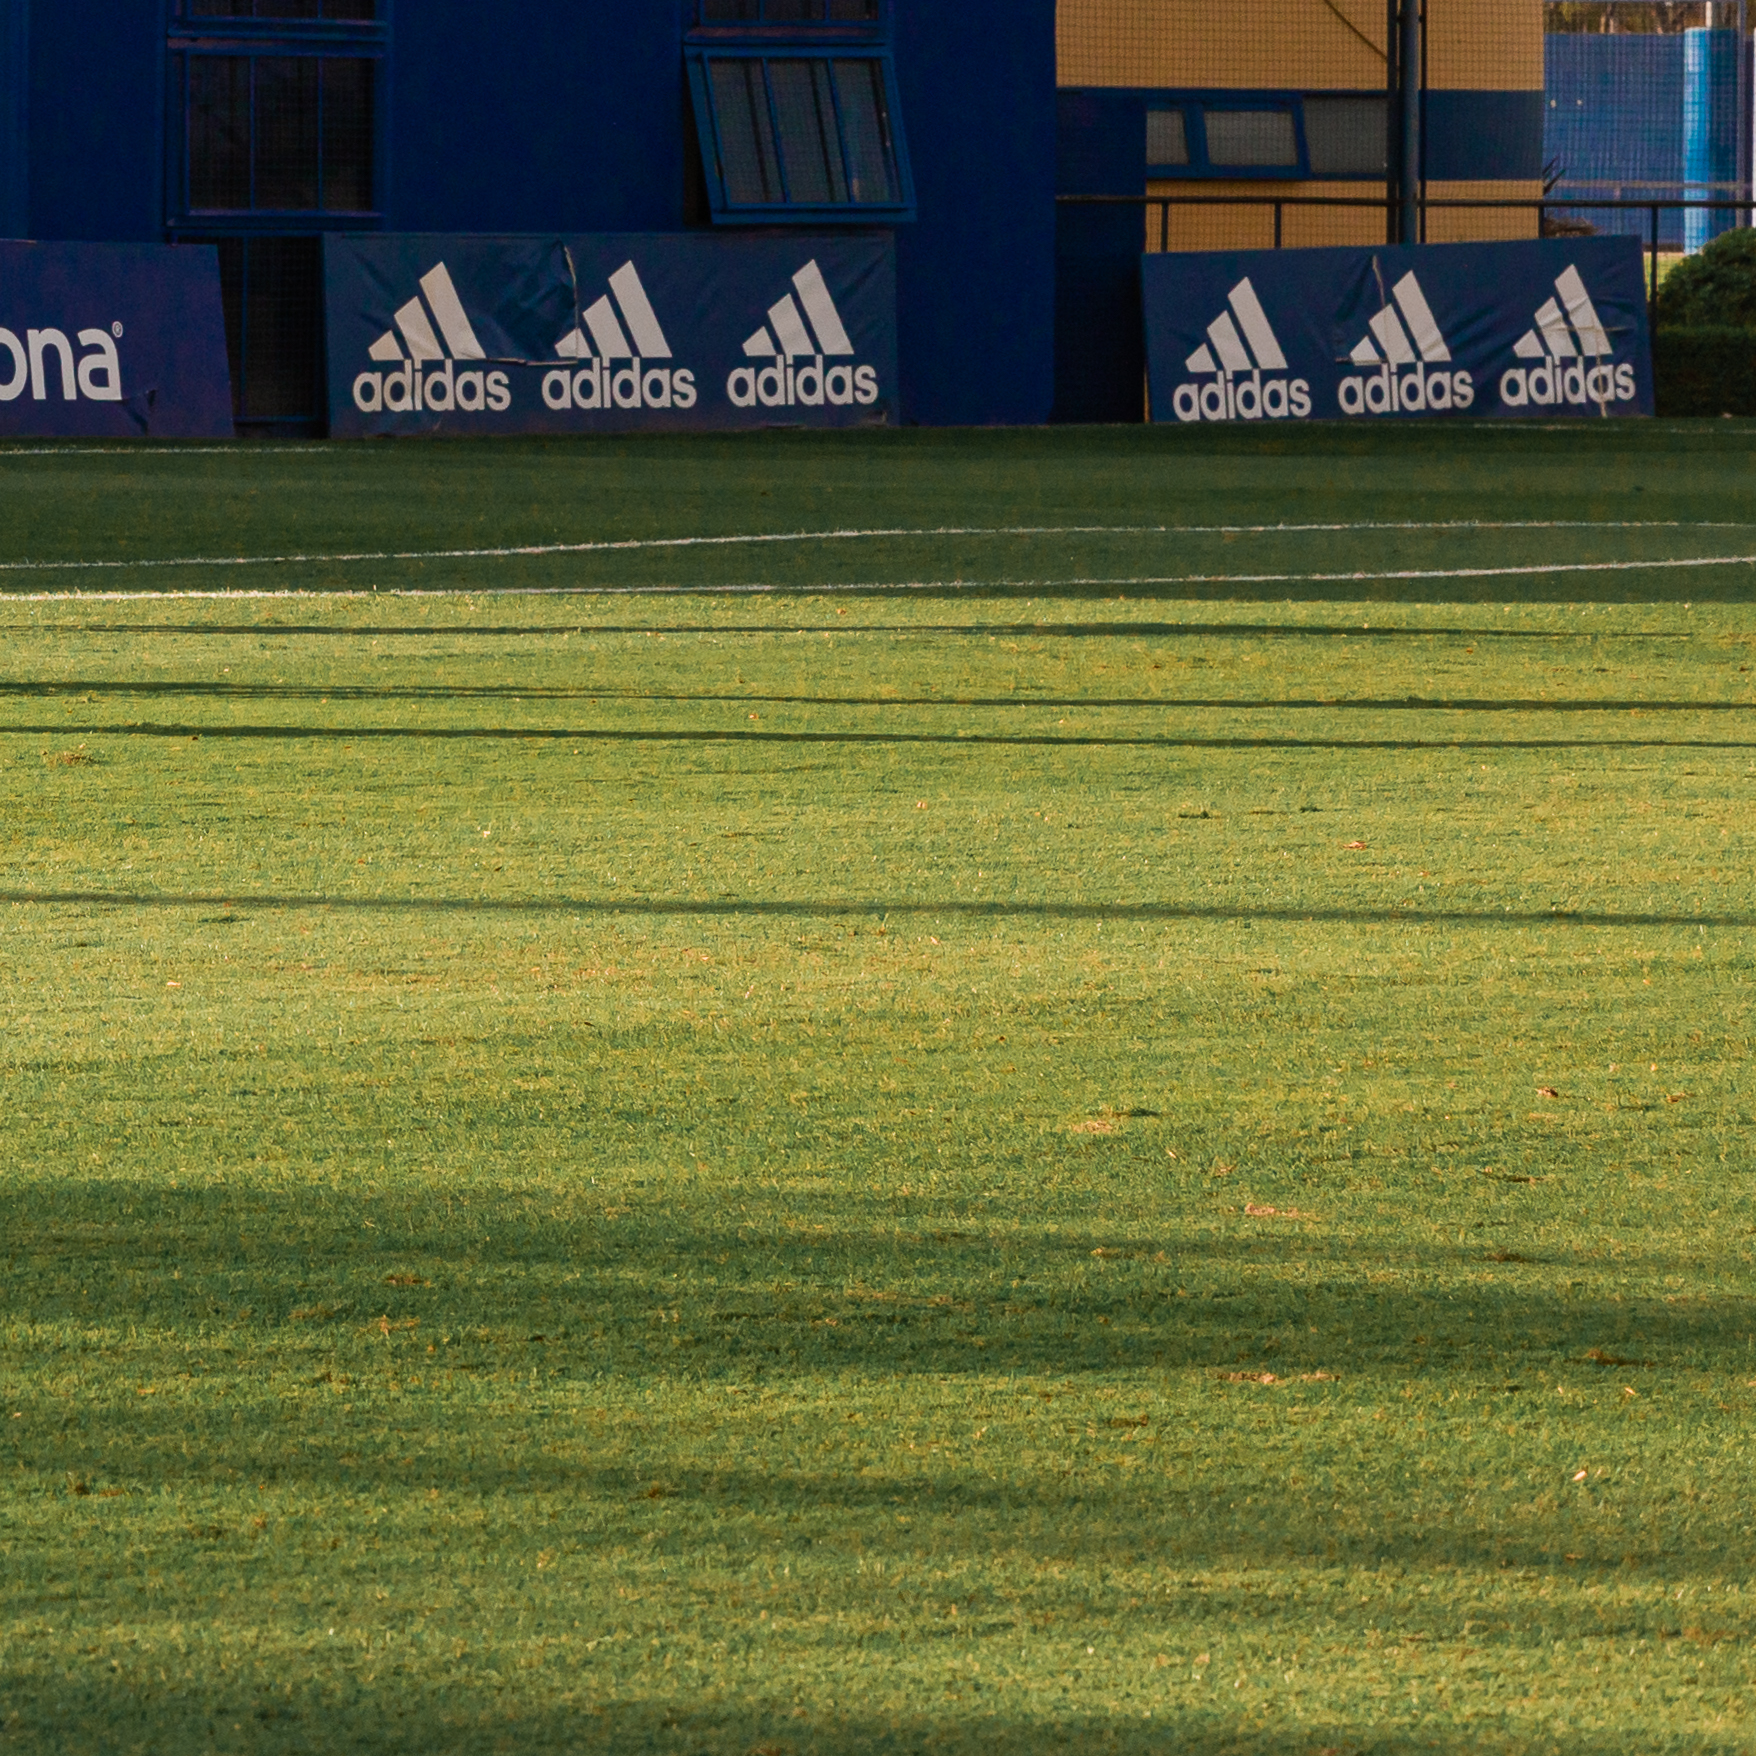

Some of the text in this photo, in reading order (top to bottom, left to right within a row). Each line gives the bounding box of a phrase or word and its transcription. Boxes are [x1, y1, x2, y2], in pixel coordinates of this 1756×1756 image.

[353, 355, 879, 412] adidas adidas adidas
[1172, 356, 1636, 422] adidas adidas adidas
